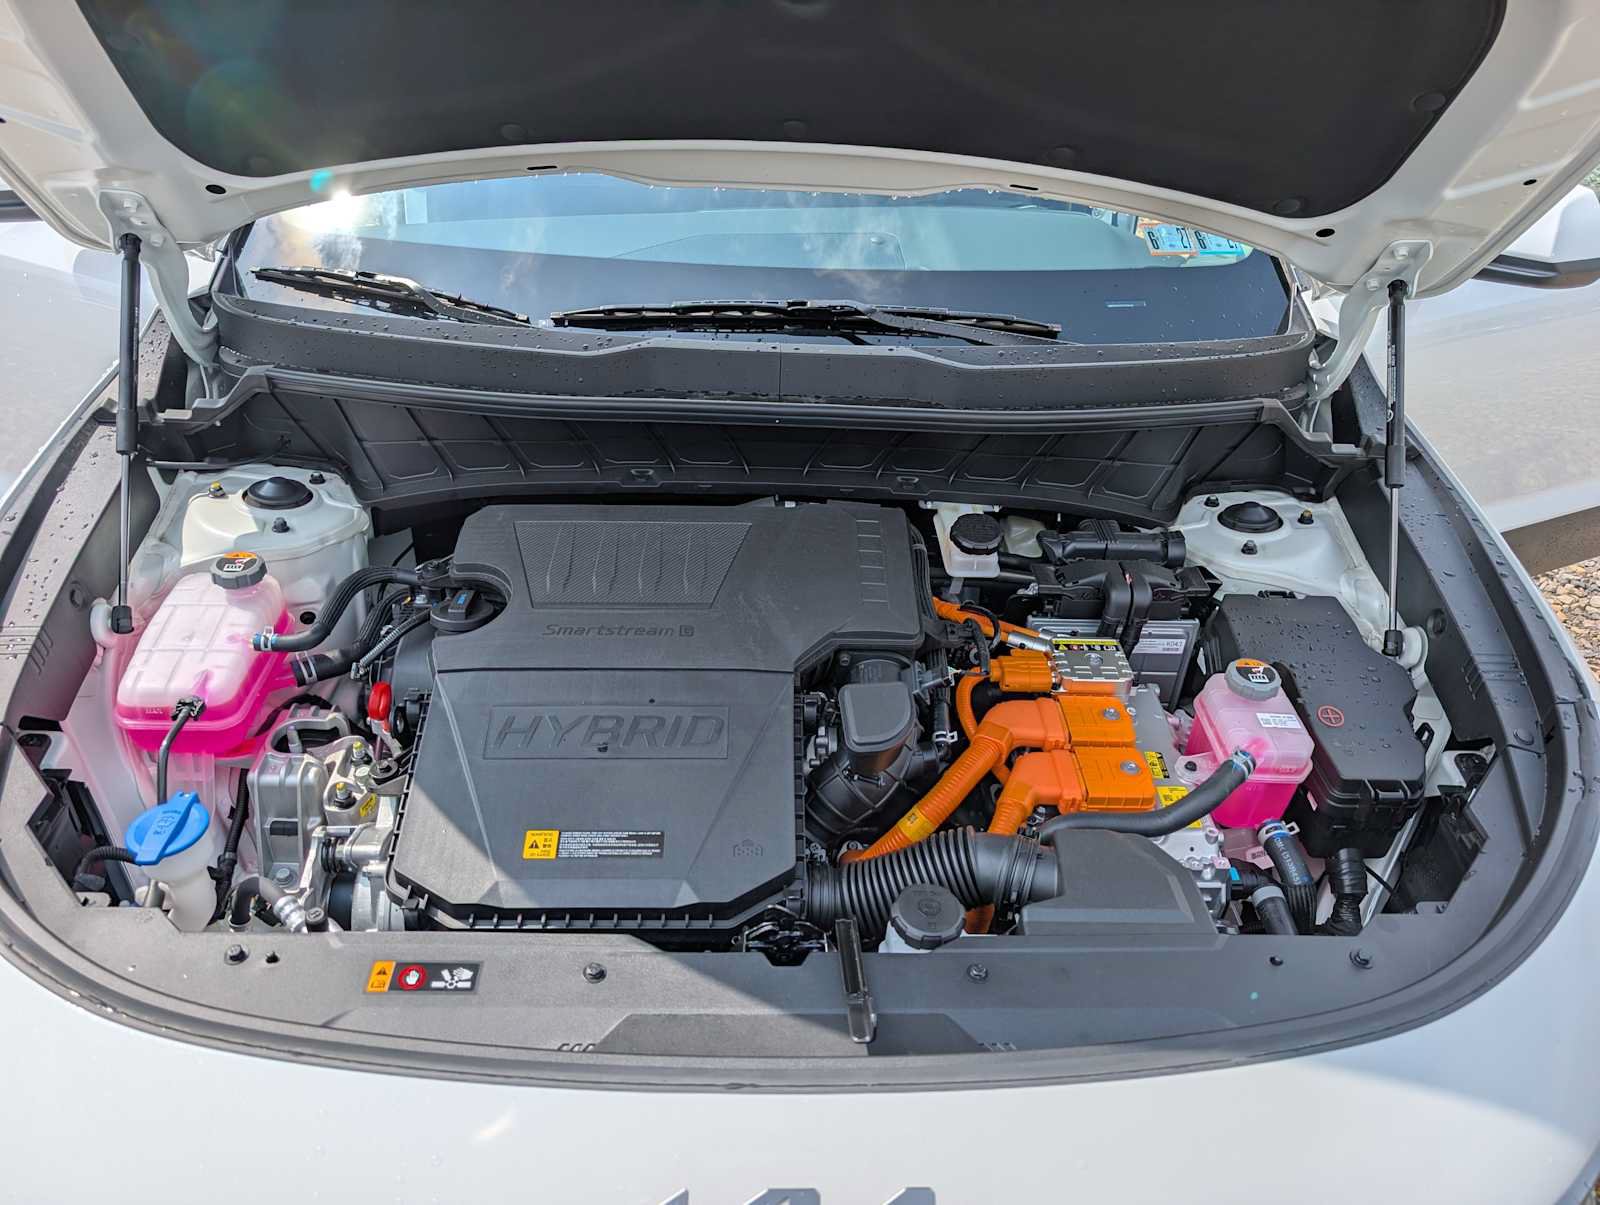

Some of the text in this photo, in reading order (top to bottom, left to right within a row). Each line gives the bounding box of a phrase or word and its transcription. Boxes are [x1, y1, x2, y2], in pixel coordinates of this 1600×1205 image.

[1148, 231, 1160, 249] 6
[1195, 230, 1207, 249] 6
[542, 624, 674, 637] Smartstream
[495, 714, 726, 748] HYBRID
